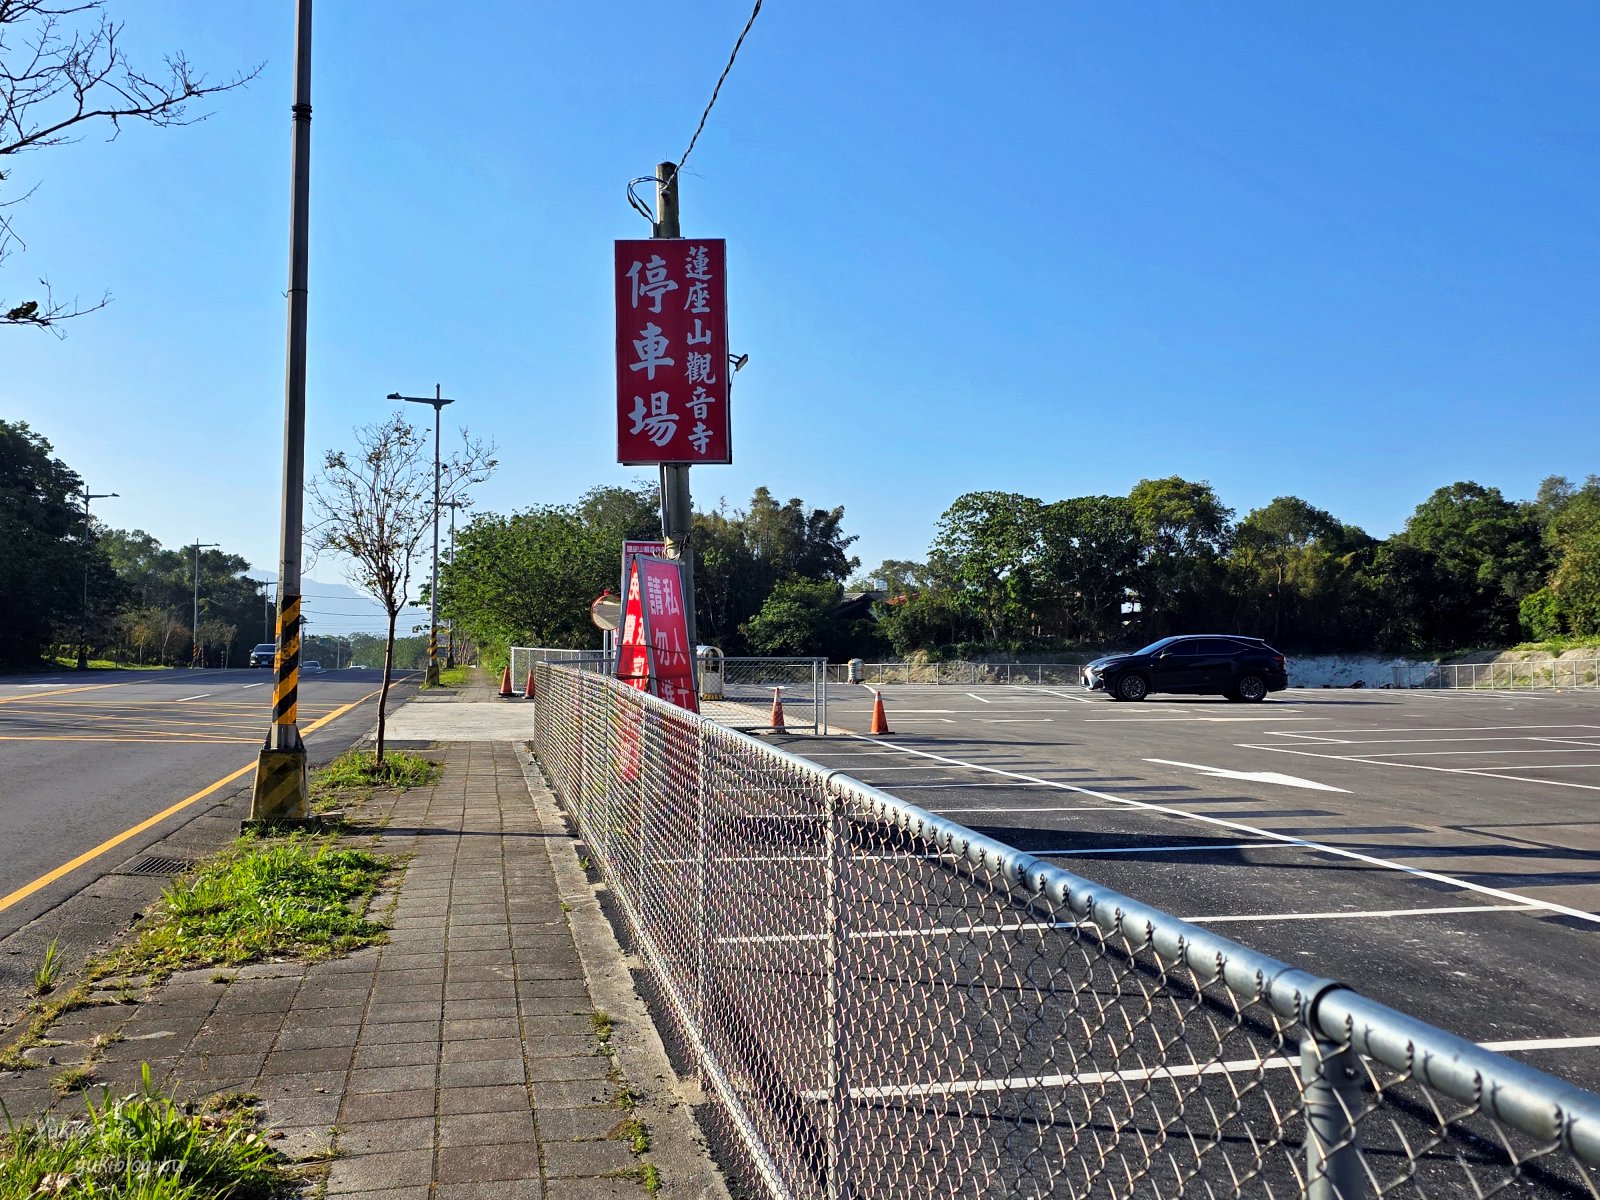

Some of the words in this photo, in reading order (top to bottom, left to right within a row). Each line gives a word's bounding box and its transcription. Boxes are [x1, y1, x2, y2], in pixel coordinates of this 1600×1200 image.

[626, 254, 680, 447] 停車場
[684, 245, 717, 455] 蓮座山觀音寺
